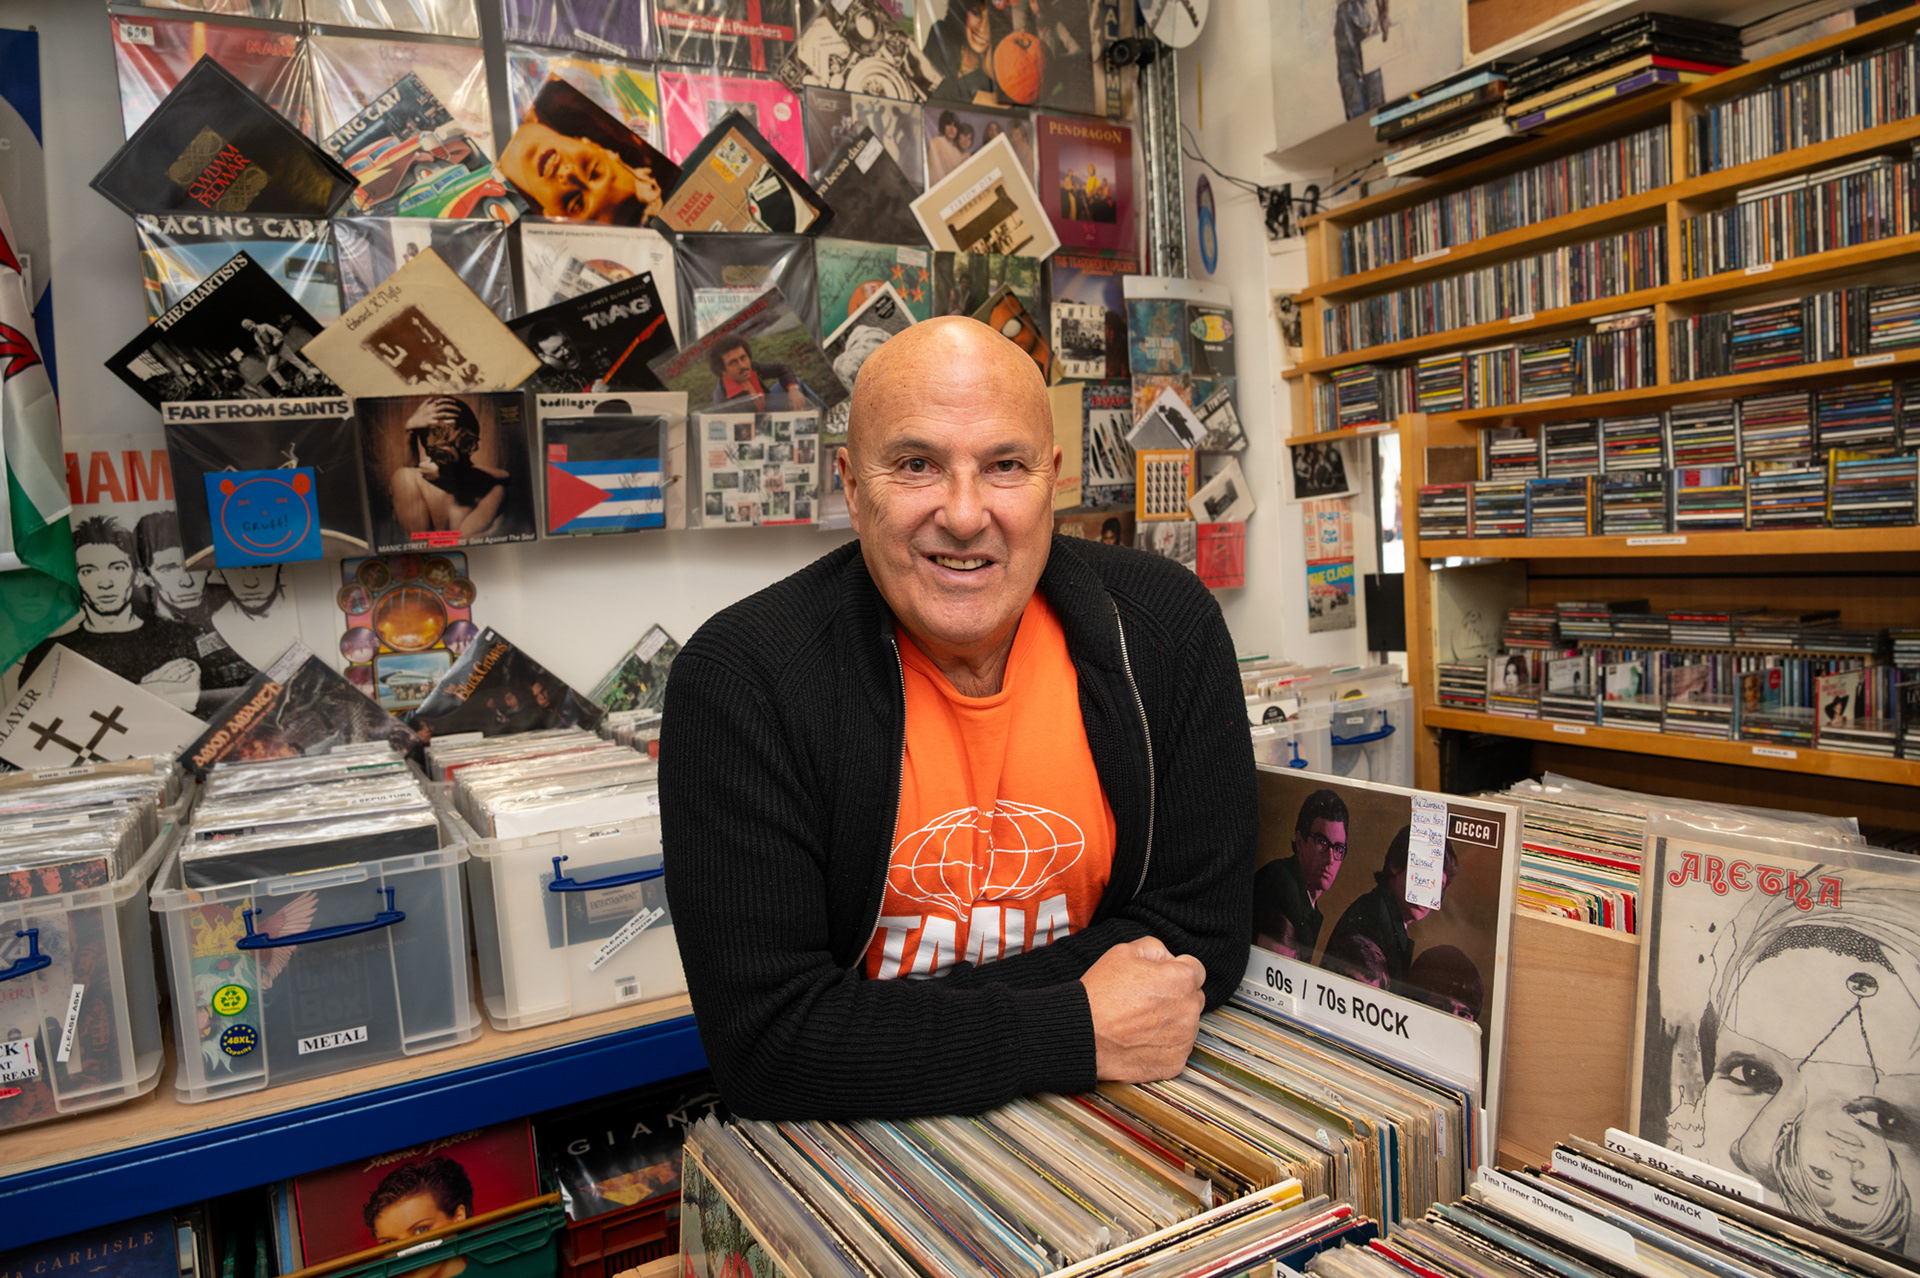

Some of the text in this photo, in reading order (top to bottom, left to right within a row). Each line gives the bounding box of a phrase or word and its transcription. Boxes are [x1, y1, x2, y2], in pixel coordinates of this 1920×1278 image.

[733, 19, 783, 39] Preachers
[1048, 121, 1122, 144] PENDRAGON
[824, 158, 850, 186] becso
[848, 140, 867, 161] dam
[198, 152, 251, 209] PEDWAR
[677, 190, 704, 220] PARSEL
[139, 213, 255, 237] RACING
[168, 399, 349, 421] FAR FROM SAINTS
[378, 545, 402, 554] MANIC
[403, 542, 428, 552] STREET
[1326, 564, 1354, 583] CLASH
[192, 730, 231, 768] AMON
[359, 792, 413, 804] SEPULTURA
[1454, 820, 1491, 841] DECCA
[590, 890, 640, 910] ENTERTAINMENT
[594, 955, 605, 966] WE
[606, 936, 629, 956] MIGHT
[630, 918, 653, 936] KNOW
[600, 914, 645, 953] PLEASE ASK
[1254, 990, 1275, 1003] POP
[1266, 966, 1293, 995] 60s
[1316, 984, 1347, 1015] 70s
[1352, 996, 1410, 1040] ROCK
[64, 991, 82, 1053] PLEASE ASK
[225, 1045, 252, 1056] Capacity
[226, 1035, 251, 1045] 48XL
[303, 1029, 365, 1052] METAL
[3, 1068, 36, 1082] REAR
[567, 1100, 721, 1156] GIANT
[1554, 1151, 1635, 1191] Geno Washington
[1482, 1172, 1575, 1223] Tina Turner 3Degrees
[1653, 1193, 1703, 1220] WOMACK
[34, 1231, 155, 1275] CARLISLE
